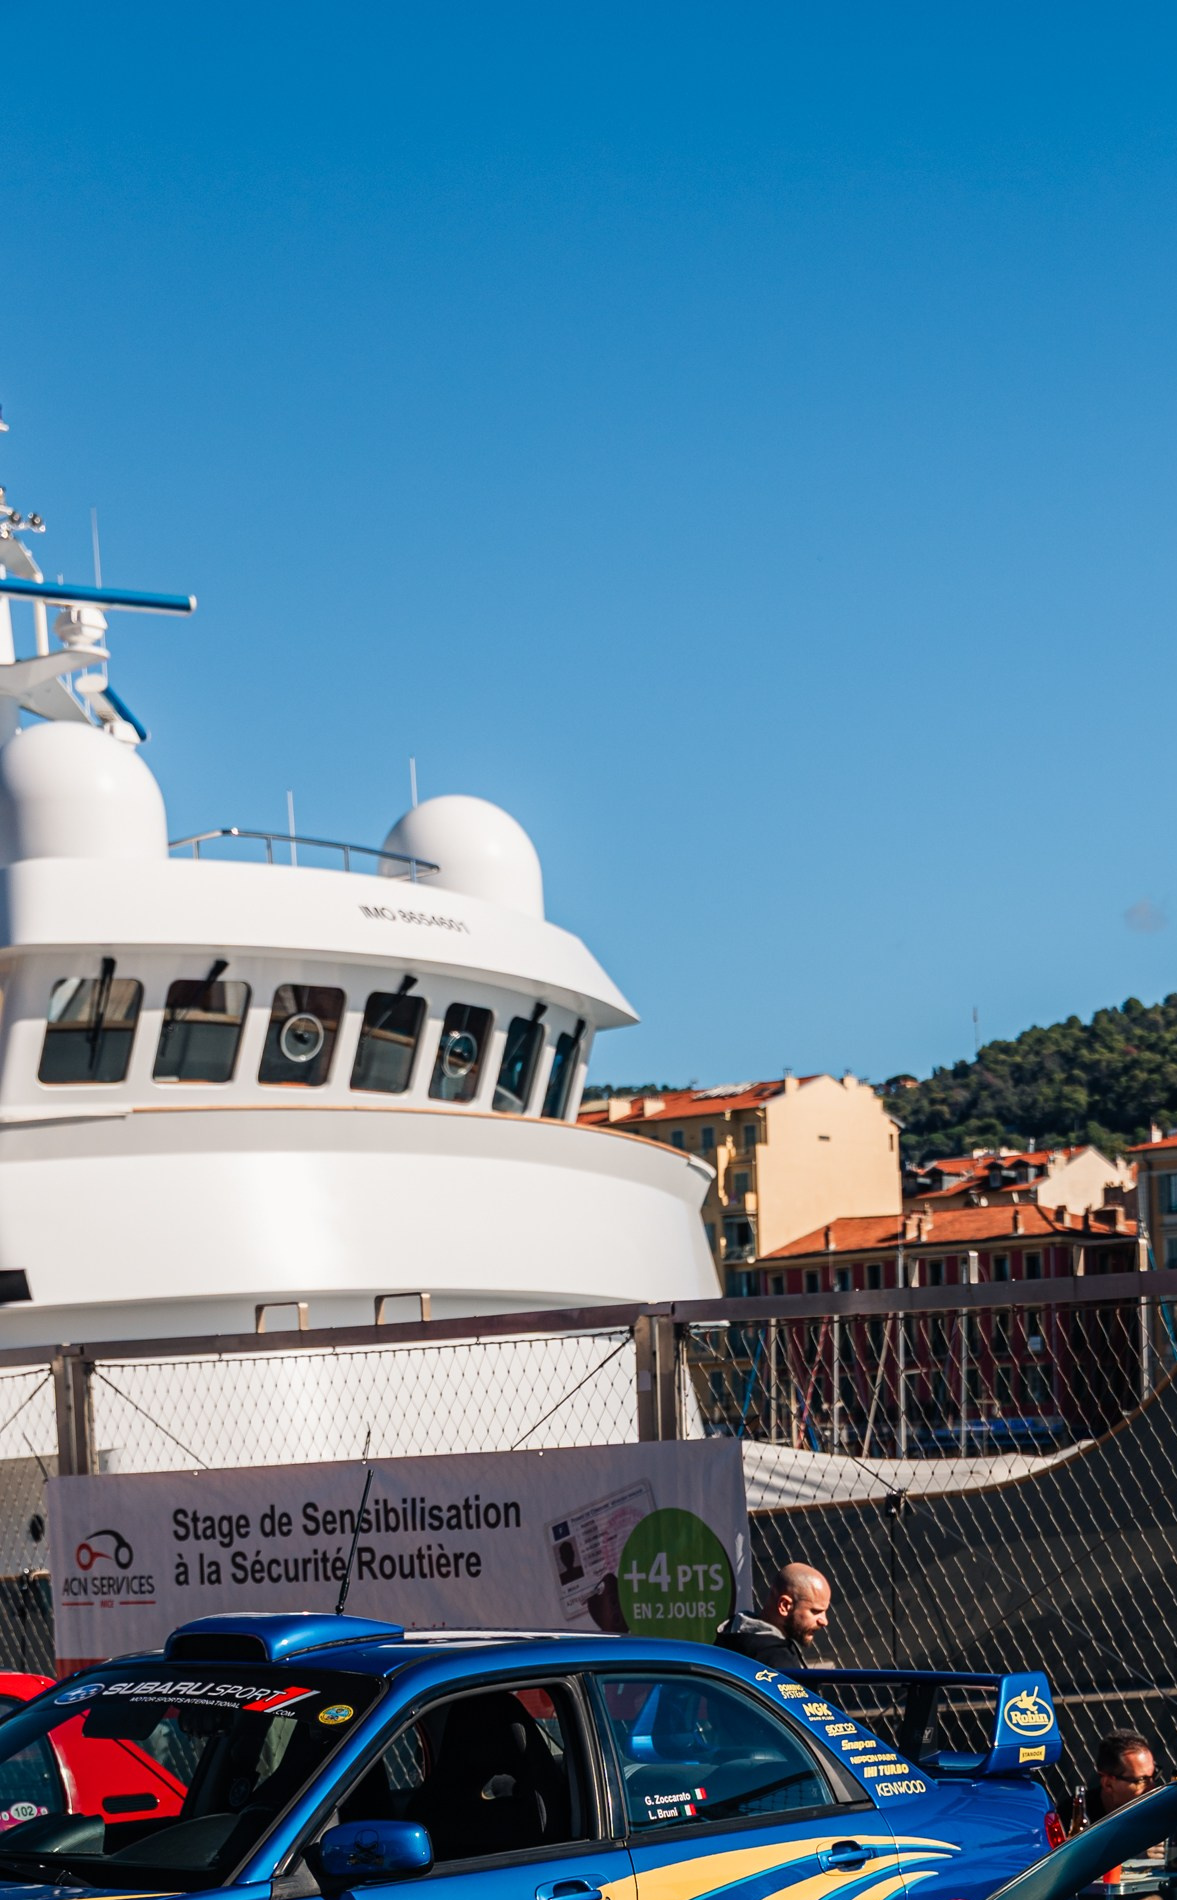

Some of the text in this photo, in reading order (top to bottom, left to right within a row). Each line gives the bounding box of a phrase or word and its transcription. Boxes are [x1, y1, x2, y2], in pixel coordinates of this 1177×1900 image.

[358, 904, 470, 935] IMO 8654601
[172, 1494, 521, 1548] Stage de Sensibilisation
[174, 1543, 482, 1586] à la Sécurité Routière
[624, 1552, 671, 1593] +4
[677, 1564, 724, 1592] PTS
[62, 1575, 155, 1597] ACN SERVICES
[633, 1601, 716, 1619] EN 2 JOURS
[102, 1681, 215, 1695] SUBARU
[207, 1684, 287, 1702] SPORT
[185, 1697, 240, 1709] INTERNATIONAL
[802, 1703, 832, 1716] NGK
[1010, 1710, 1049, 1725] Robin
[825, 1723, 857, 1736] sparco
[841, 1740, 876, 1751] Snap-on
[850, 1755, 878, 1764] NIPPON
[879, 1763, 909, 1776] TURBO
[875, 1780, 926, 1797] KENWOOD
[645, 1792, 691, 1805] G. Zoccarato
[15, 1806, 34, 1817] 102
[648, 1807, 678, 1820] L. Bruni
